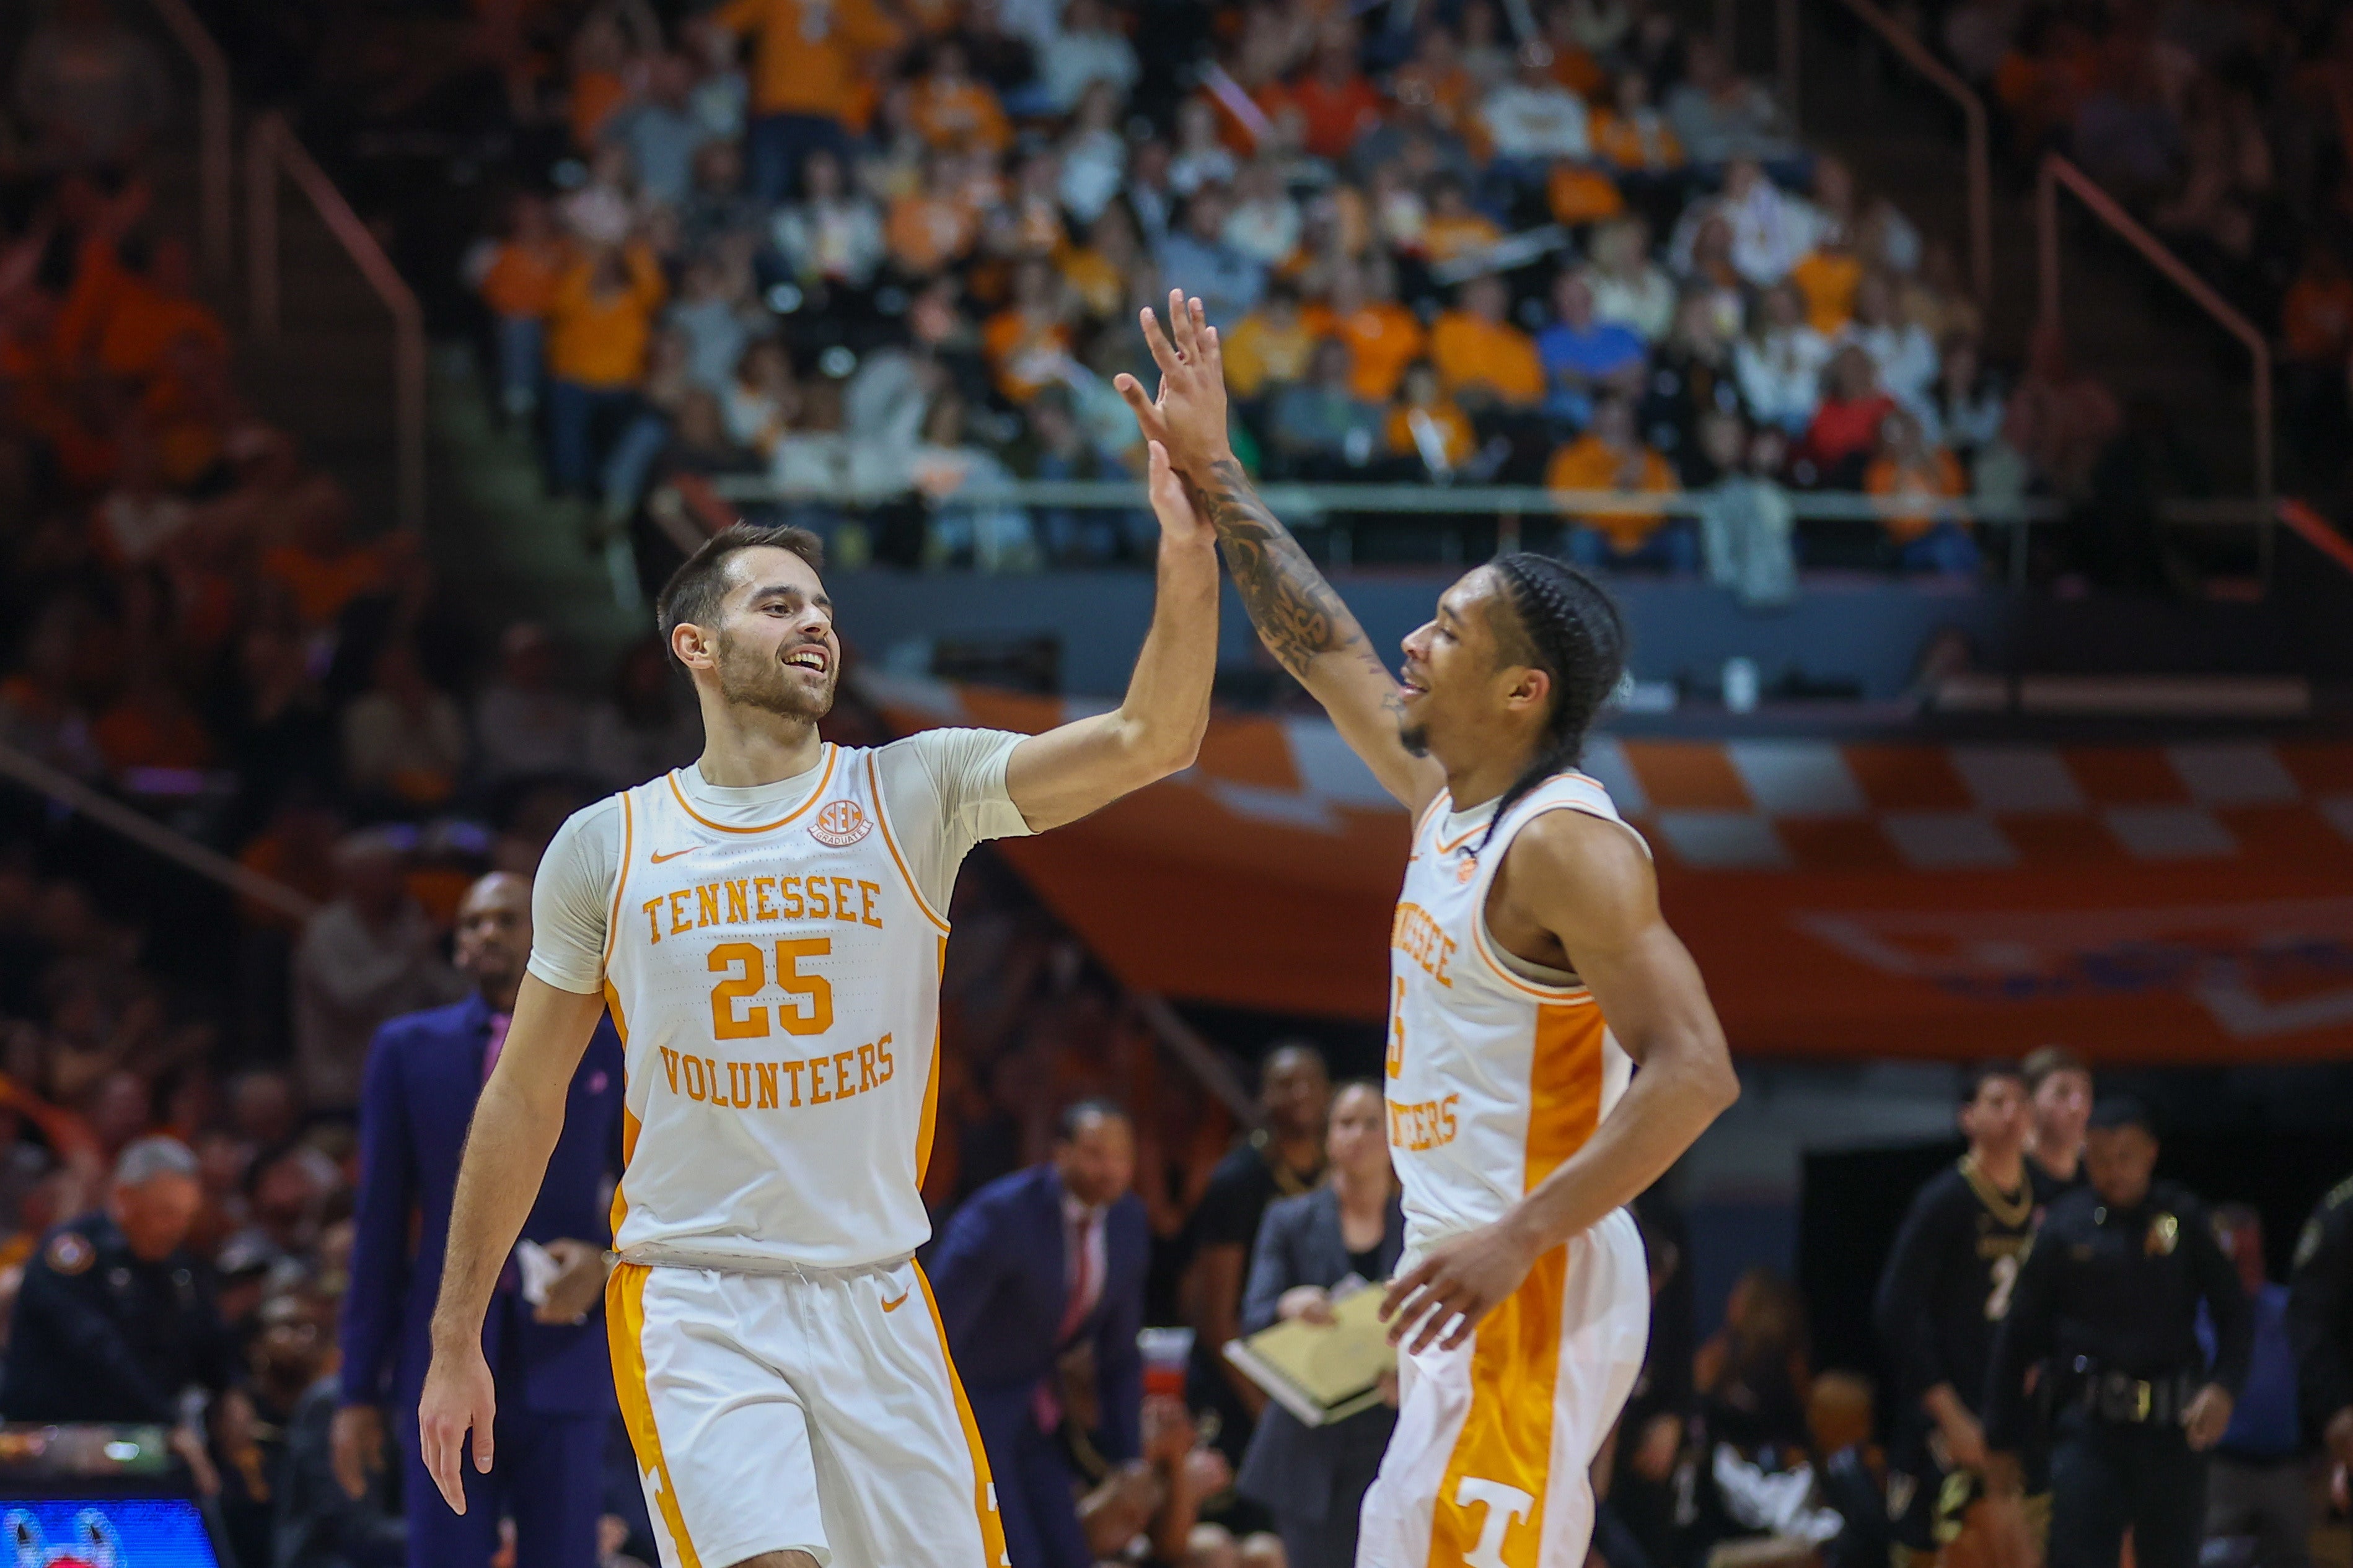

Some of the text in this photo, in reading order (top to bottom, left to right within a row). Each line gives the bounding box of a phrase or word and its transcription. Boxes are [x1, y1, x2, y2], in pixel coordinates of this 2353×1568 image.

[816, 830, 865, 844] GRADUATE
[821, 802, 860, 833] SEC
[642, 875, 884, 945] TENNESSEE
[707, 937, 833, 1040] 25
[659, 1032, 894, 1110] VOLUNTEERS
